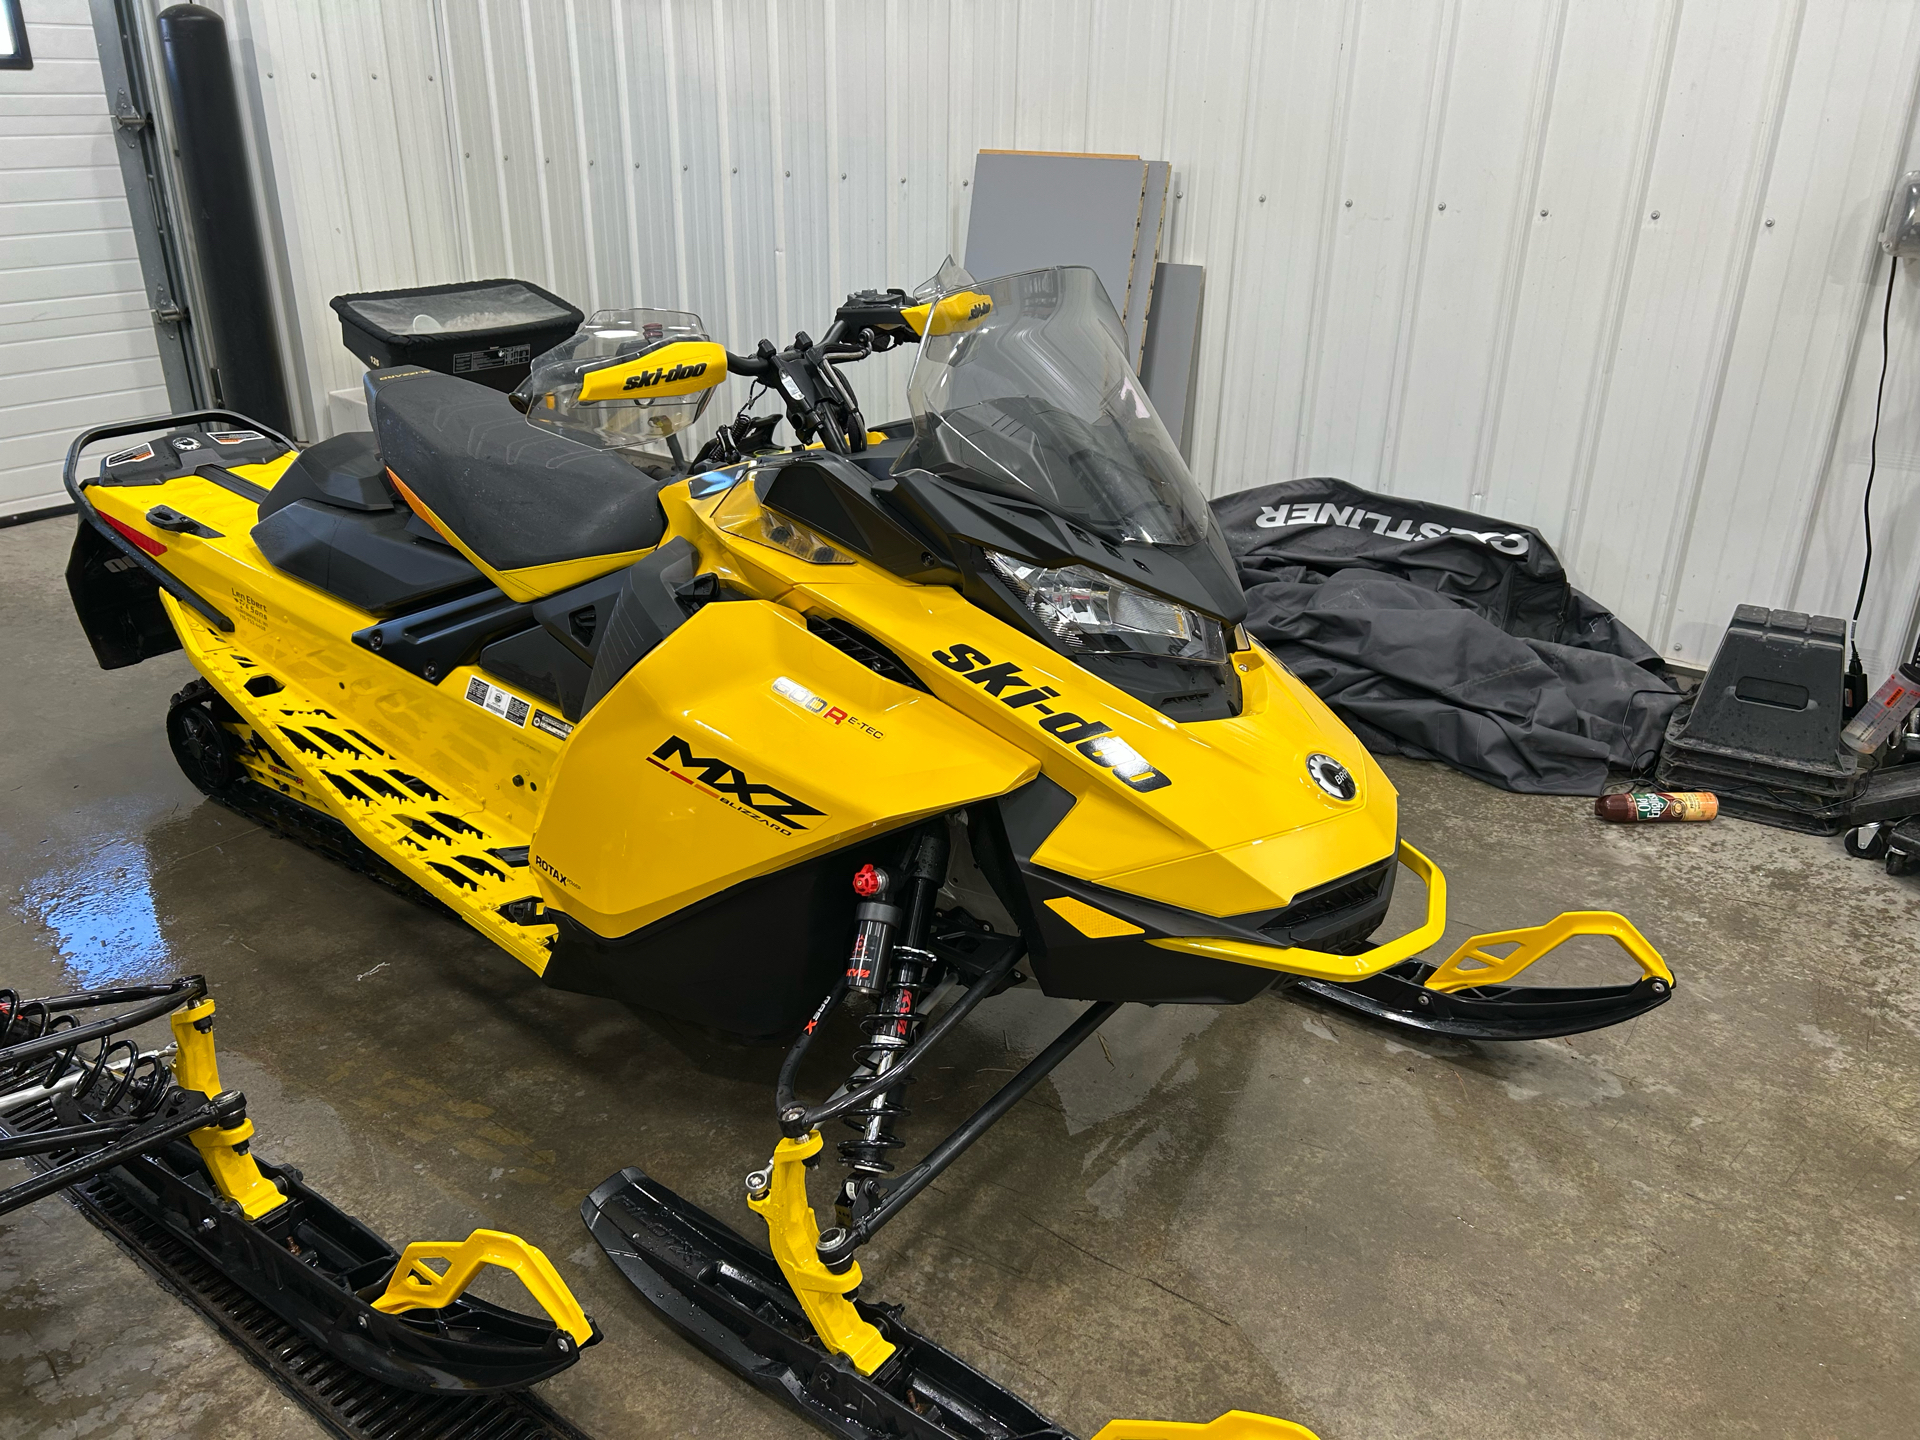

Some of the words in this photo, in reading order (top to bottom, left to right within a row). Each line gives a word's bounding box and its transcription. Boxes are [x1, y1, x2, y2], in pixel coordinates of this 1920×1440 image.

[622, 362, 708, 392] ski-doo
[847, 716, 884, 740] E-TEC
[931, 643, 1173, 794] ski-doo
[651, 734, 830, 831] MXZ
[1334, 768, 1349, 785] BRP
[719, 797, 793, 837] BLIZZARD
[1637, 798, 1651, 812] Old
[535, 854, 567, 887] ROTAX
